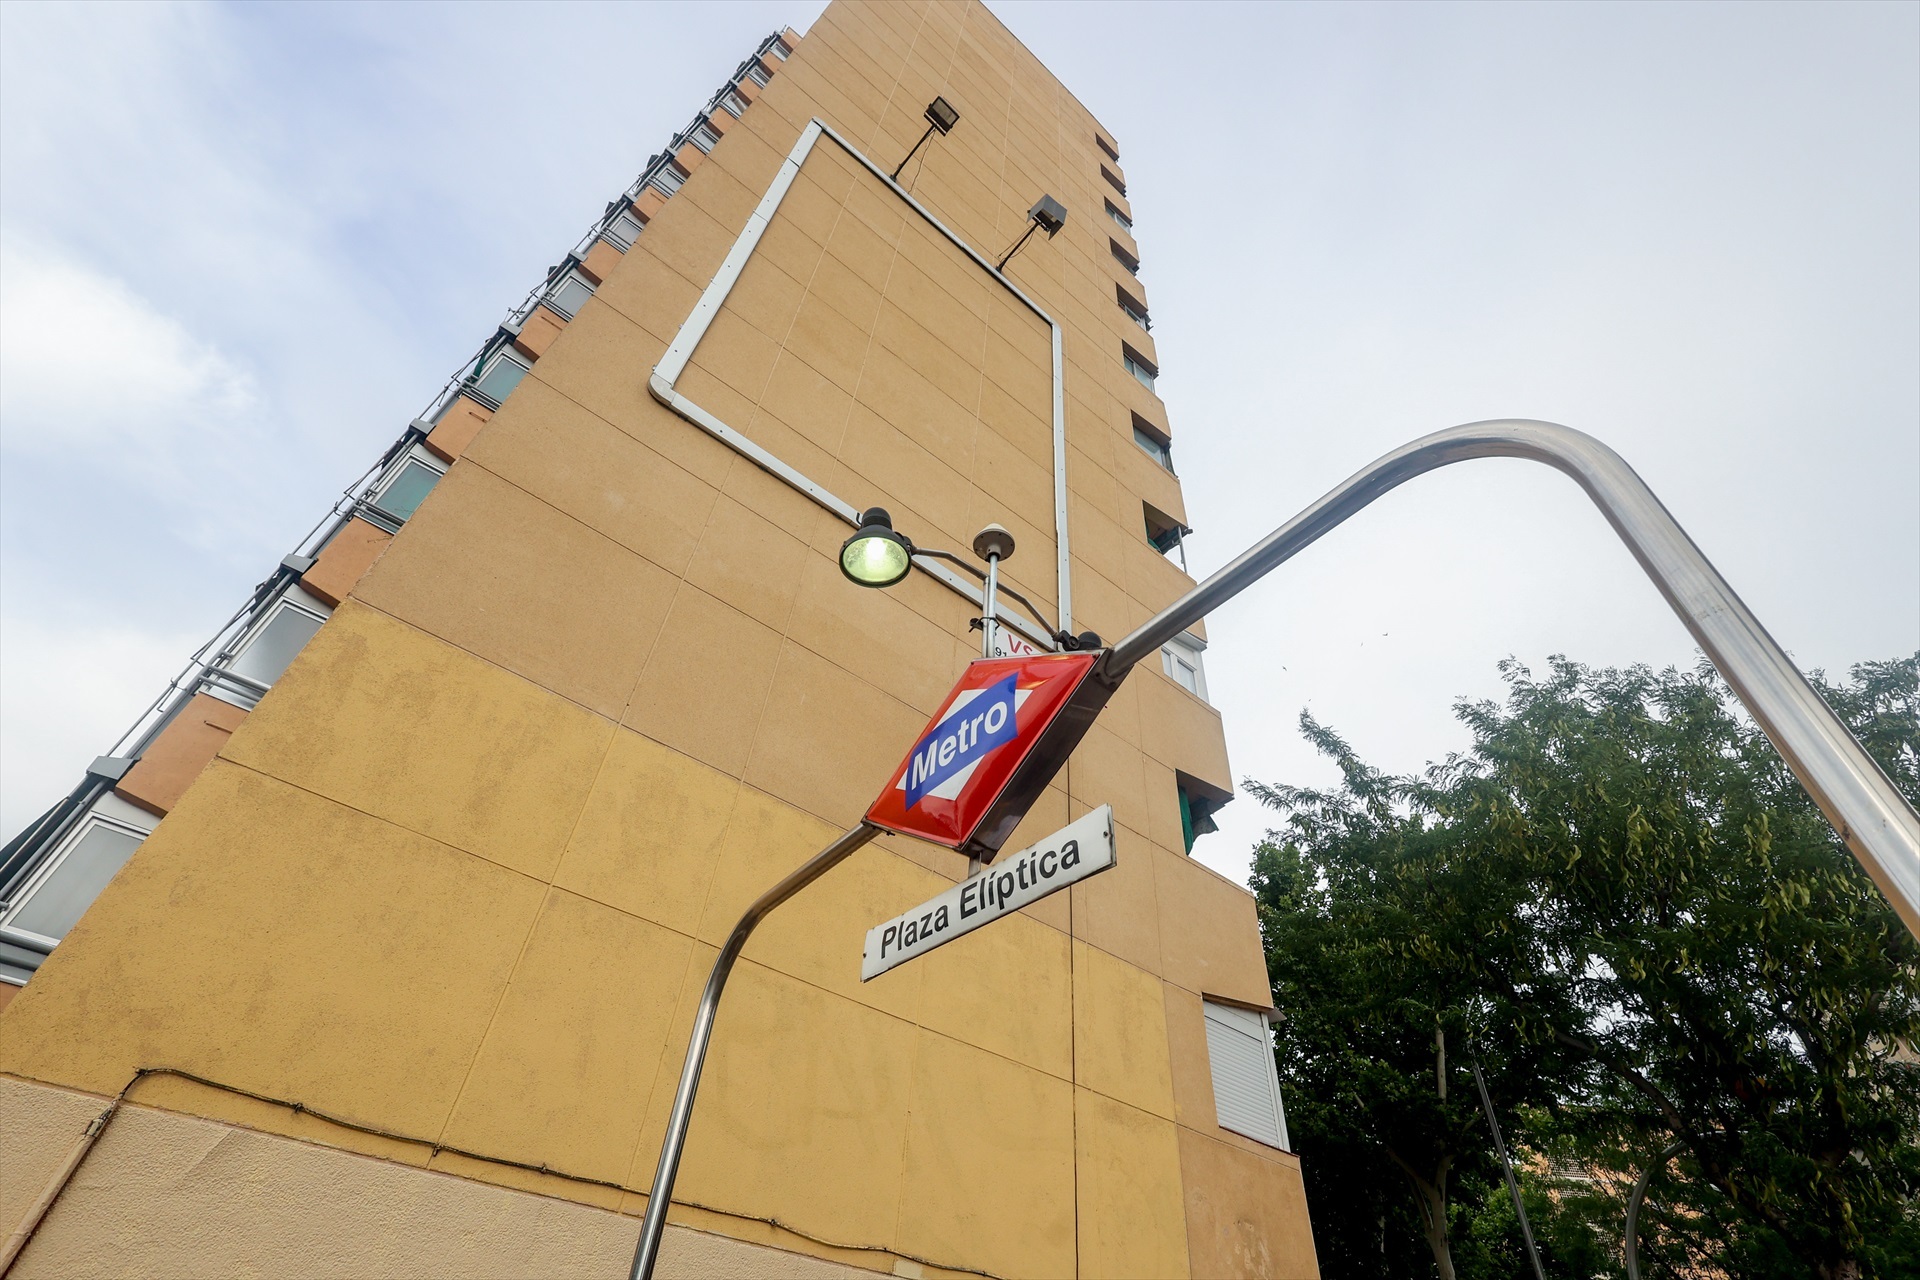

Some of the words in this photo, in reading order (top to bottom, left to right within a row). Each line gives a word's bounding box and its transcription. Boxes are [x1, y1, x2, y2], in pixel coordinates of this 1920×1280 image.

[911, 701, 1008, 791] Metro
[880, 904, 950, 960] Plaza
[960, 839, 1081, 919] Elíptica
